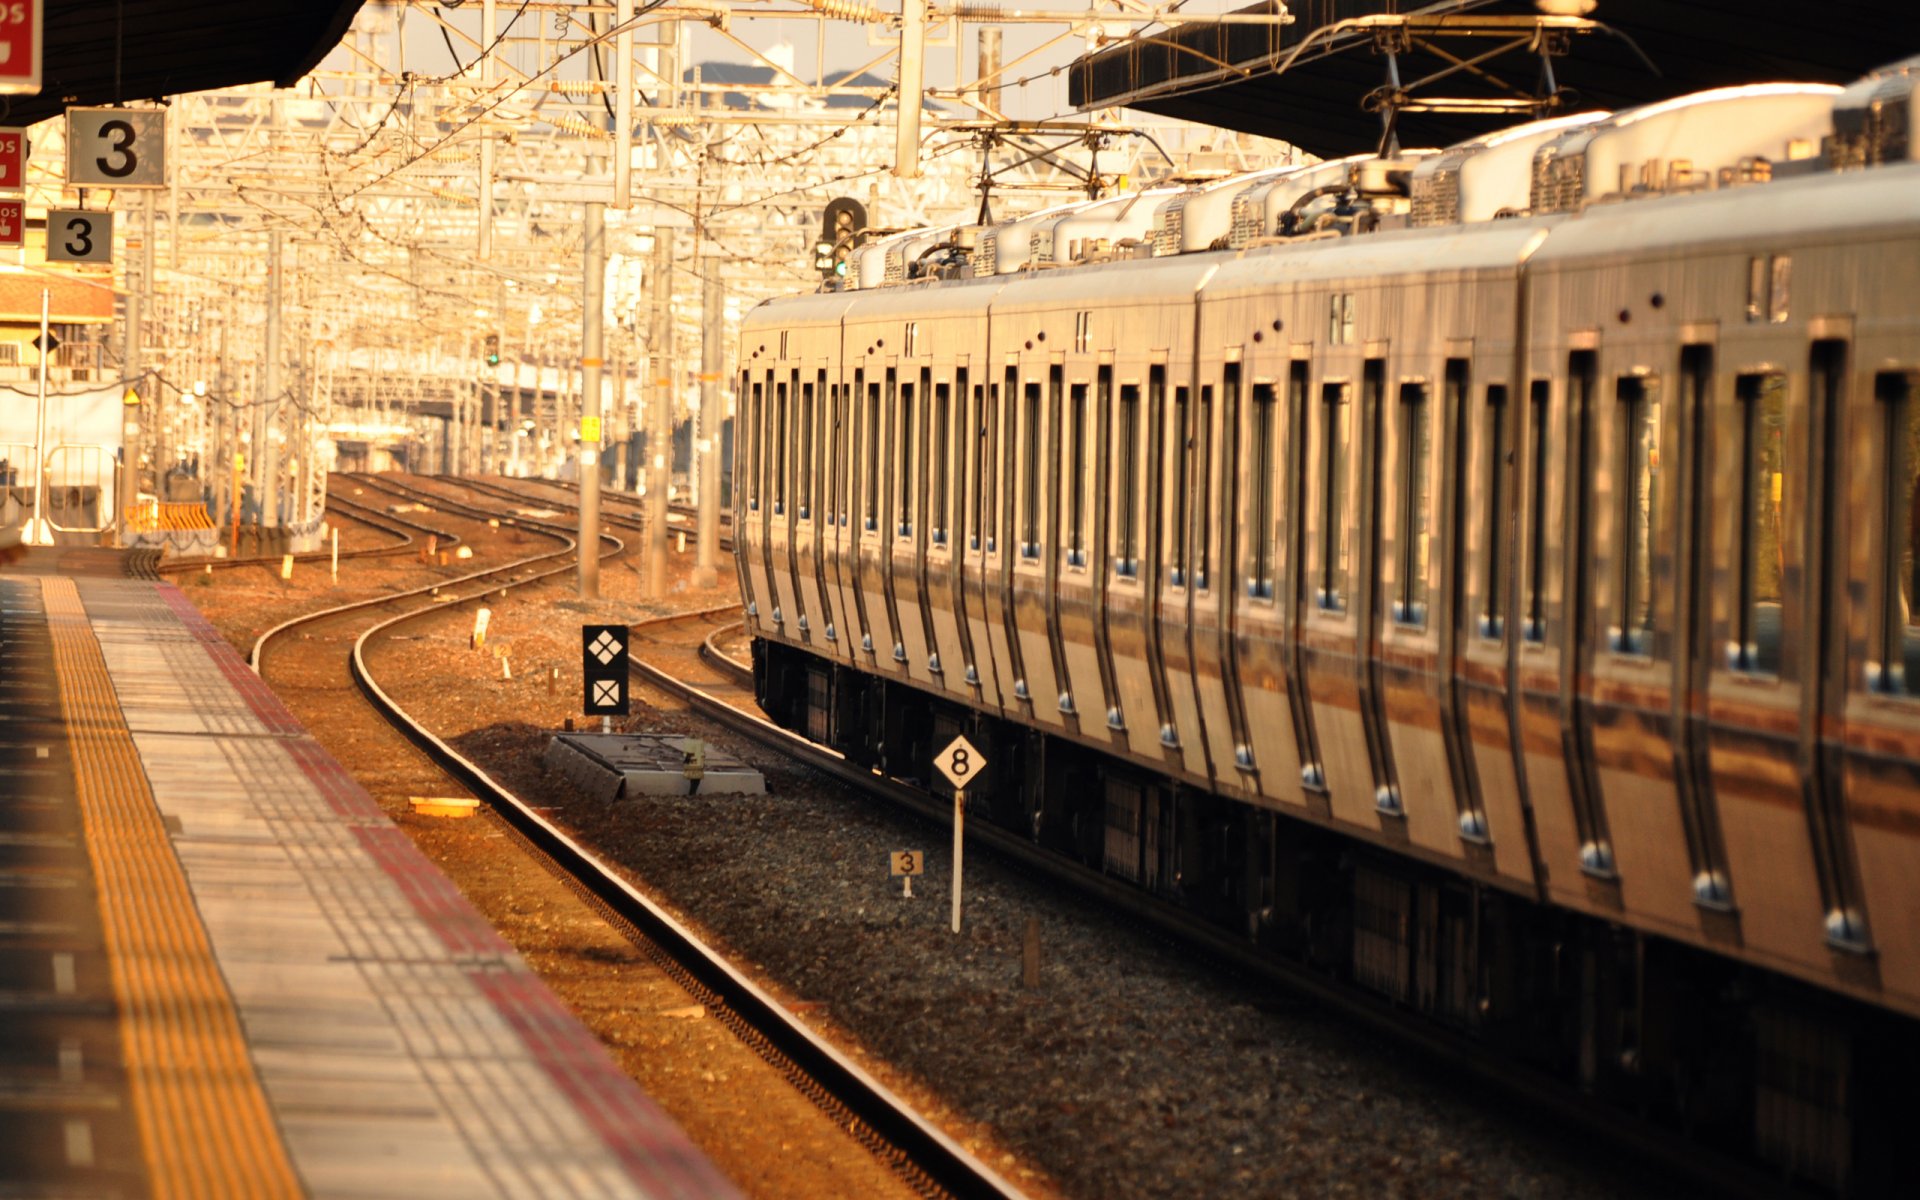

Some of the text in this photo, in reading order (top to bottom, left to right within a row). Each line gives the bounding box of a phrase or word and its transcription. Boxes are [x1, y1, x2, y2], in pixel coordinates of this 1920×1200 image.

[96, 120, 137, 177] 3
[65, 218, 93, 256] 3
[951, 748, 970, 776] 8
[900, 852, 915, 873] 3
